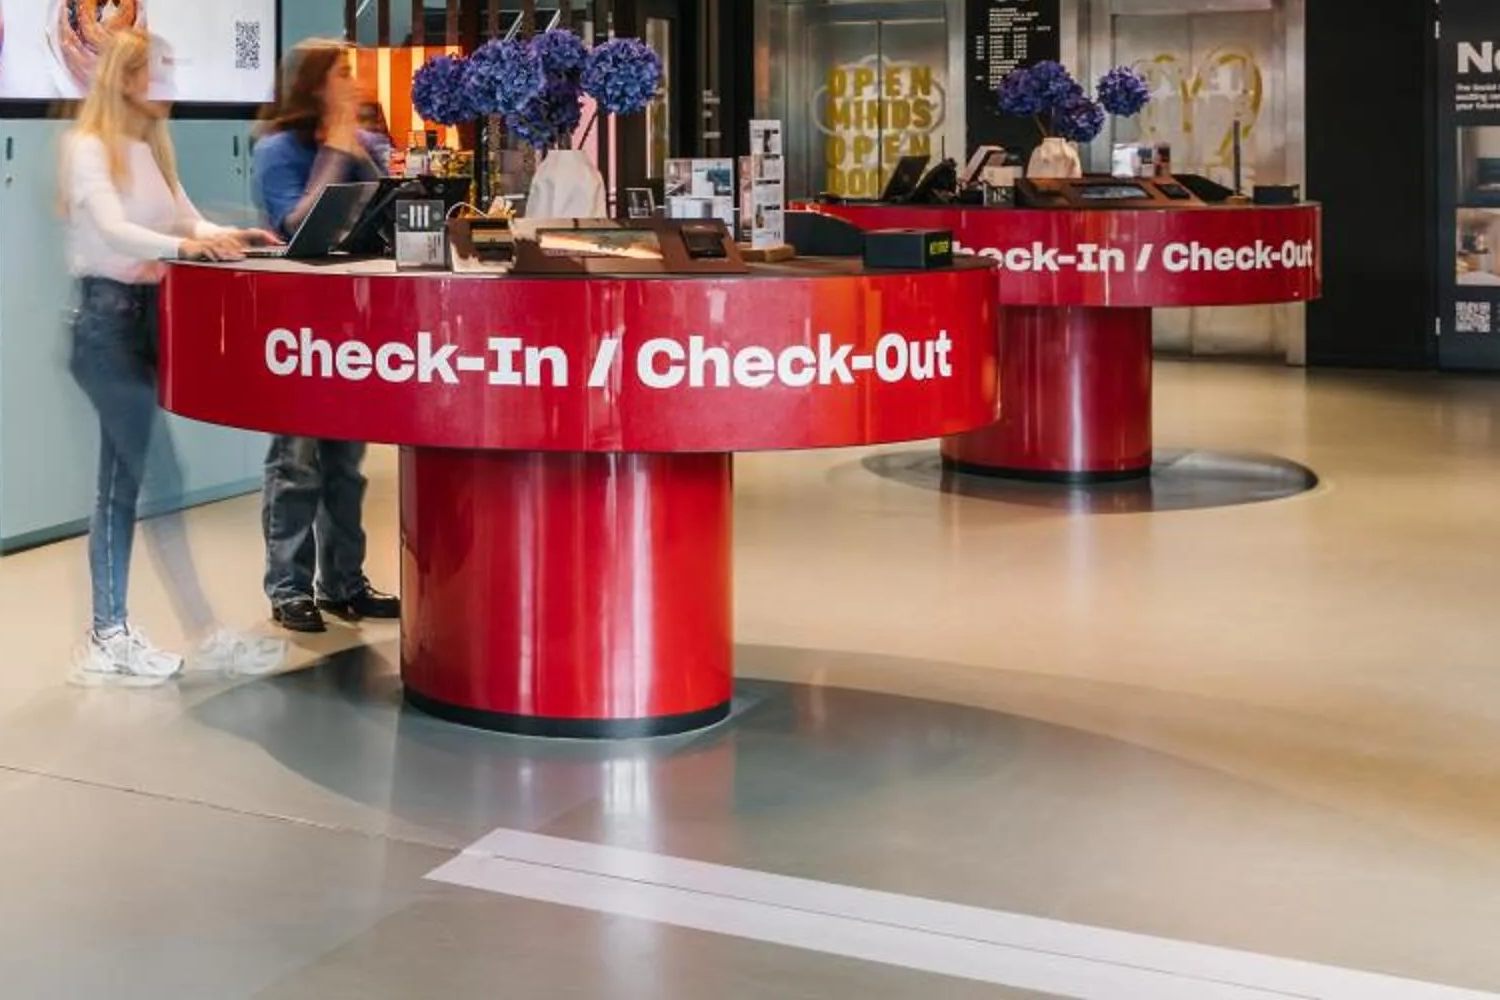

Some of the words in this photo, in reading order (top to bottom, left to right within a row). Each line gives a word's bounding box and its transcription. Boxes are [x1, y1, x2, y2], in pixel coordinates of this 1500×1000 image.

[1457, 41, 1500, 73] N
[828, 67, 932, 97] OPEN
[827, 98, 933, 130] MINDS
[826, 134, 931, 167] OPEN
[828, 168, 887, 196] DOO
[1136, 244, 1154, 272] /
[1162, 239, 1313, 273] Check-Out
[265, 328, 568, 387] Check-In
[588, 339, 619, 387] /
[637, 330, 952, 388] Check-Out
